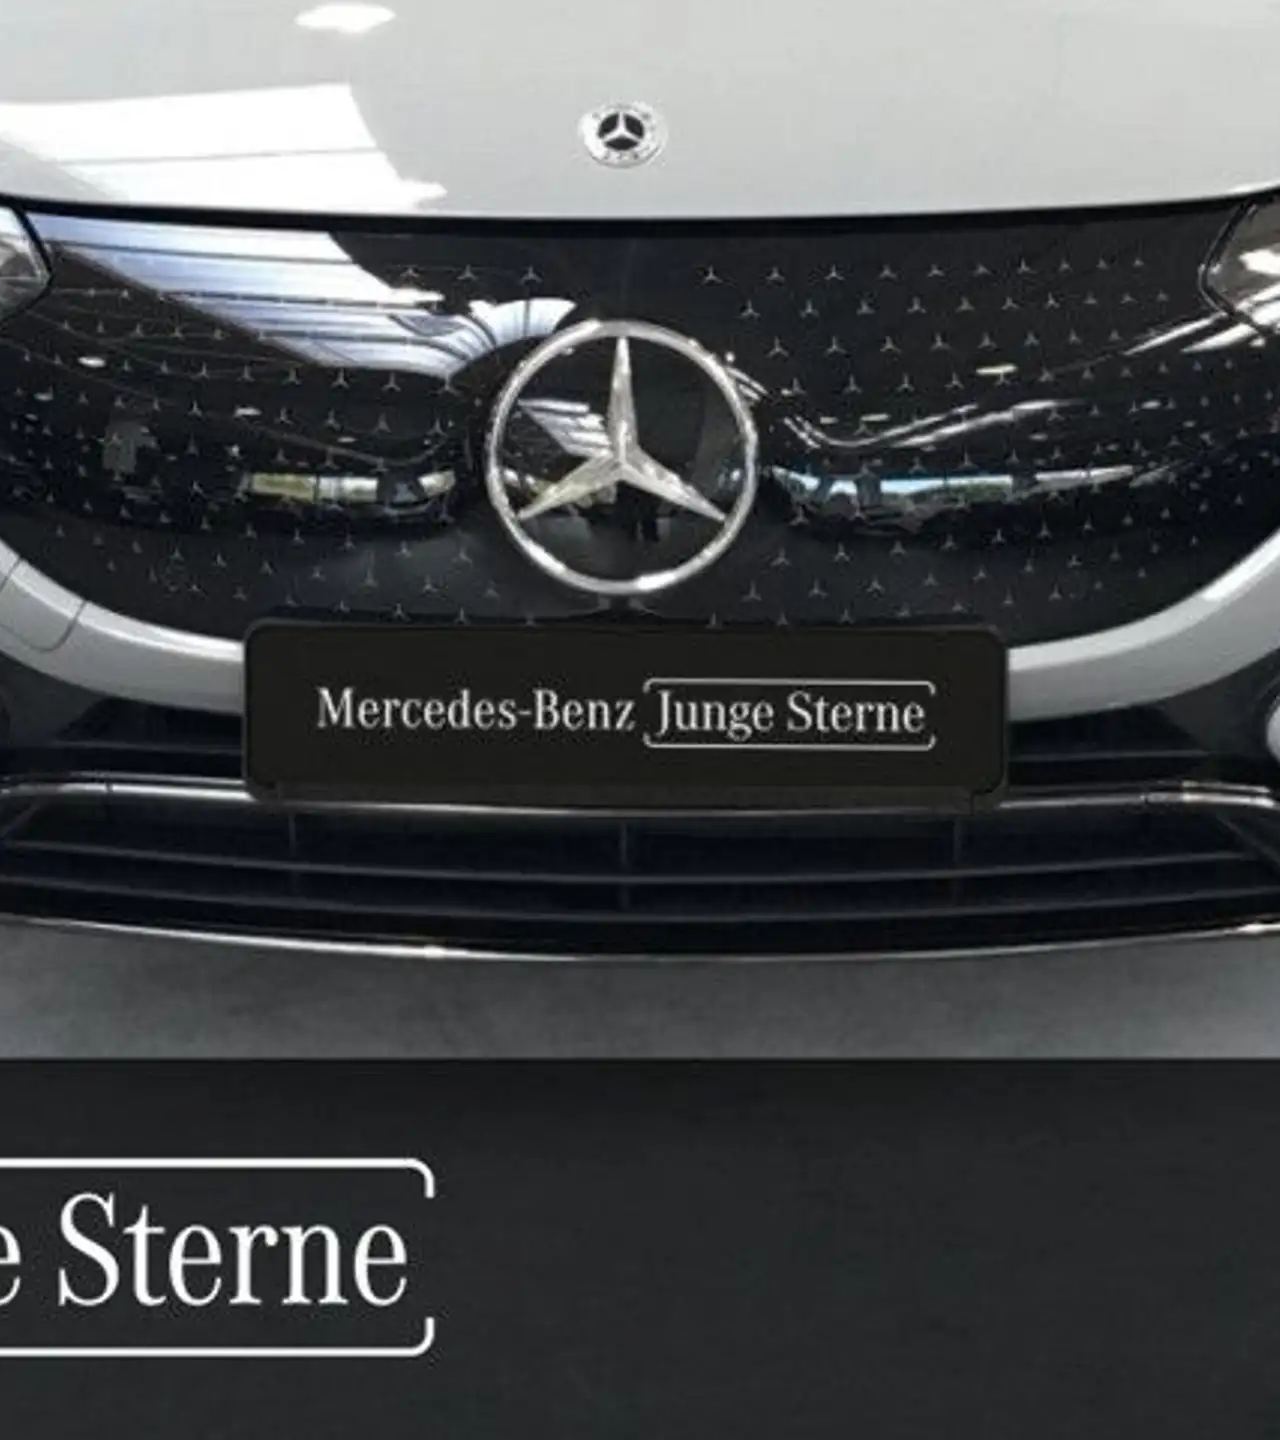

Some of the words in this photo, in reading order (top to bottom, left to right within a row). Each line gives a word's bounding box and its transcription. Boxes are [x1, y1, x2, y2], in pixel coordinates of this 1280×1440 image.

[317, 686, 635, 731] Mercedes-Benz
[656, 689, 775, 742] Junge
[786, 690, 926, 734] Sterne
